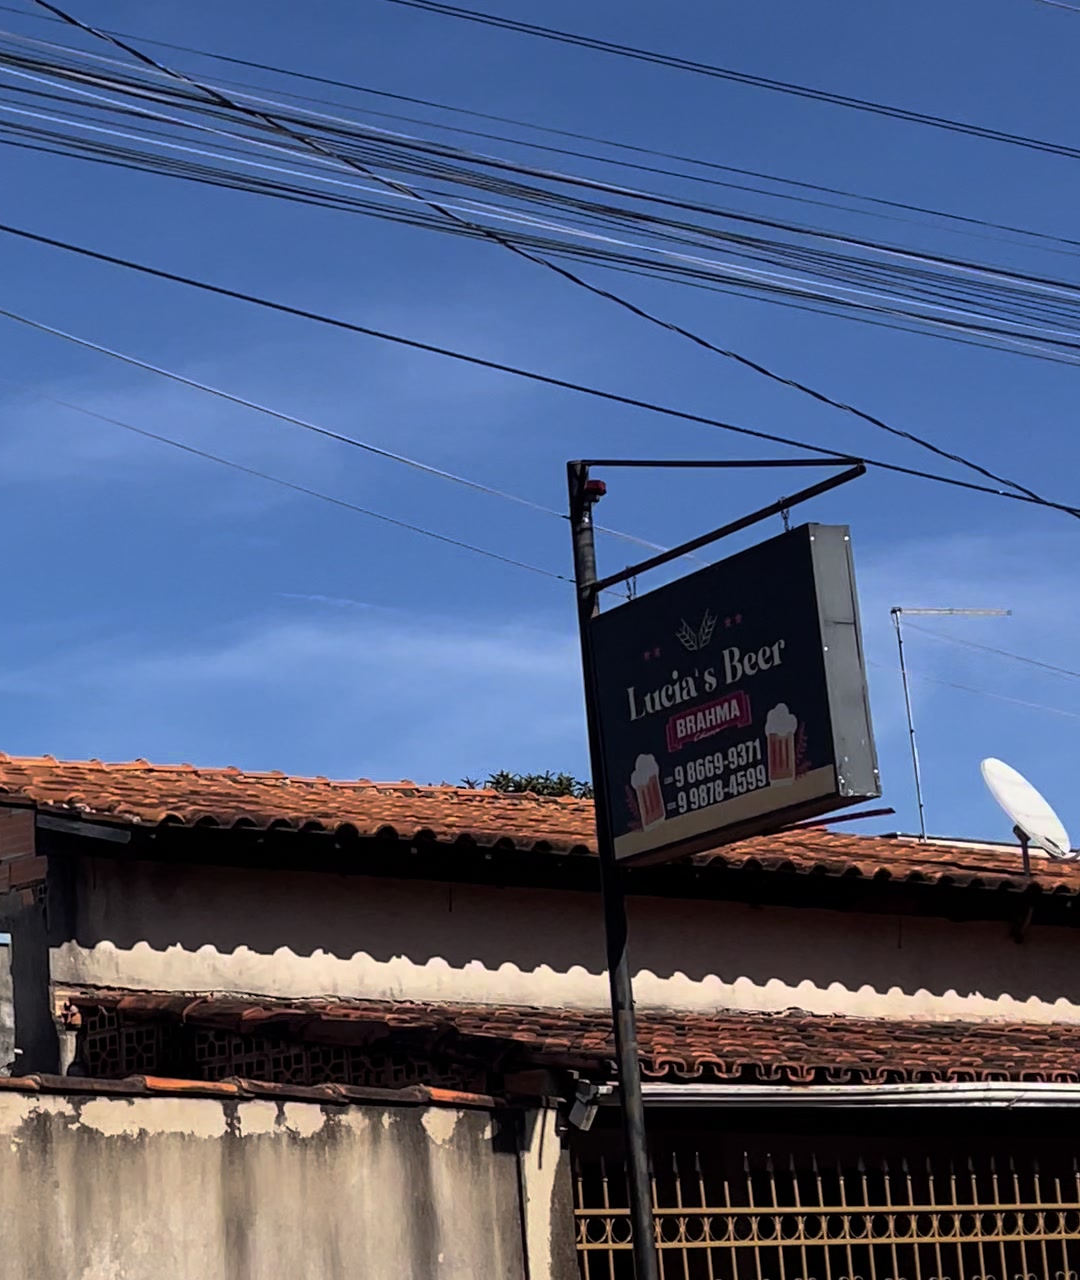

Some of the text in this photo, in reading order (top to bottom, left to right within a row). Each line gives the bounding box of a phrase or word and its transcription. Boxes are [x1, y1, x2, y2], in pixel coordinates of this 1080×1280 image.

[721, 639, 787, 685] Beer
[675, 698, 741, 739] BRAHMA
[686, 737, 762, 784] 8669-9371
[689, 763, 768, 810] 9878-4599
